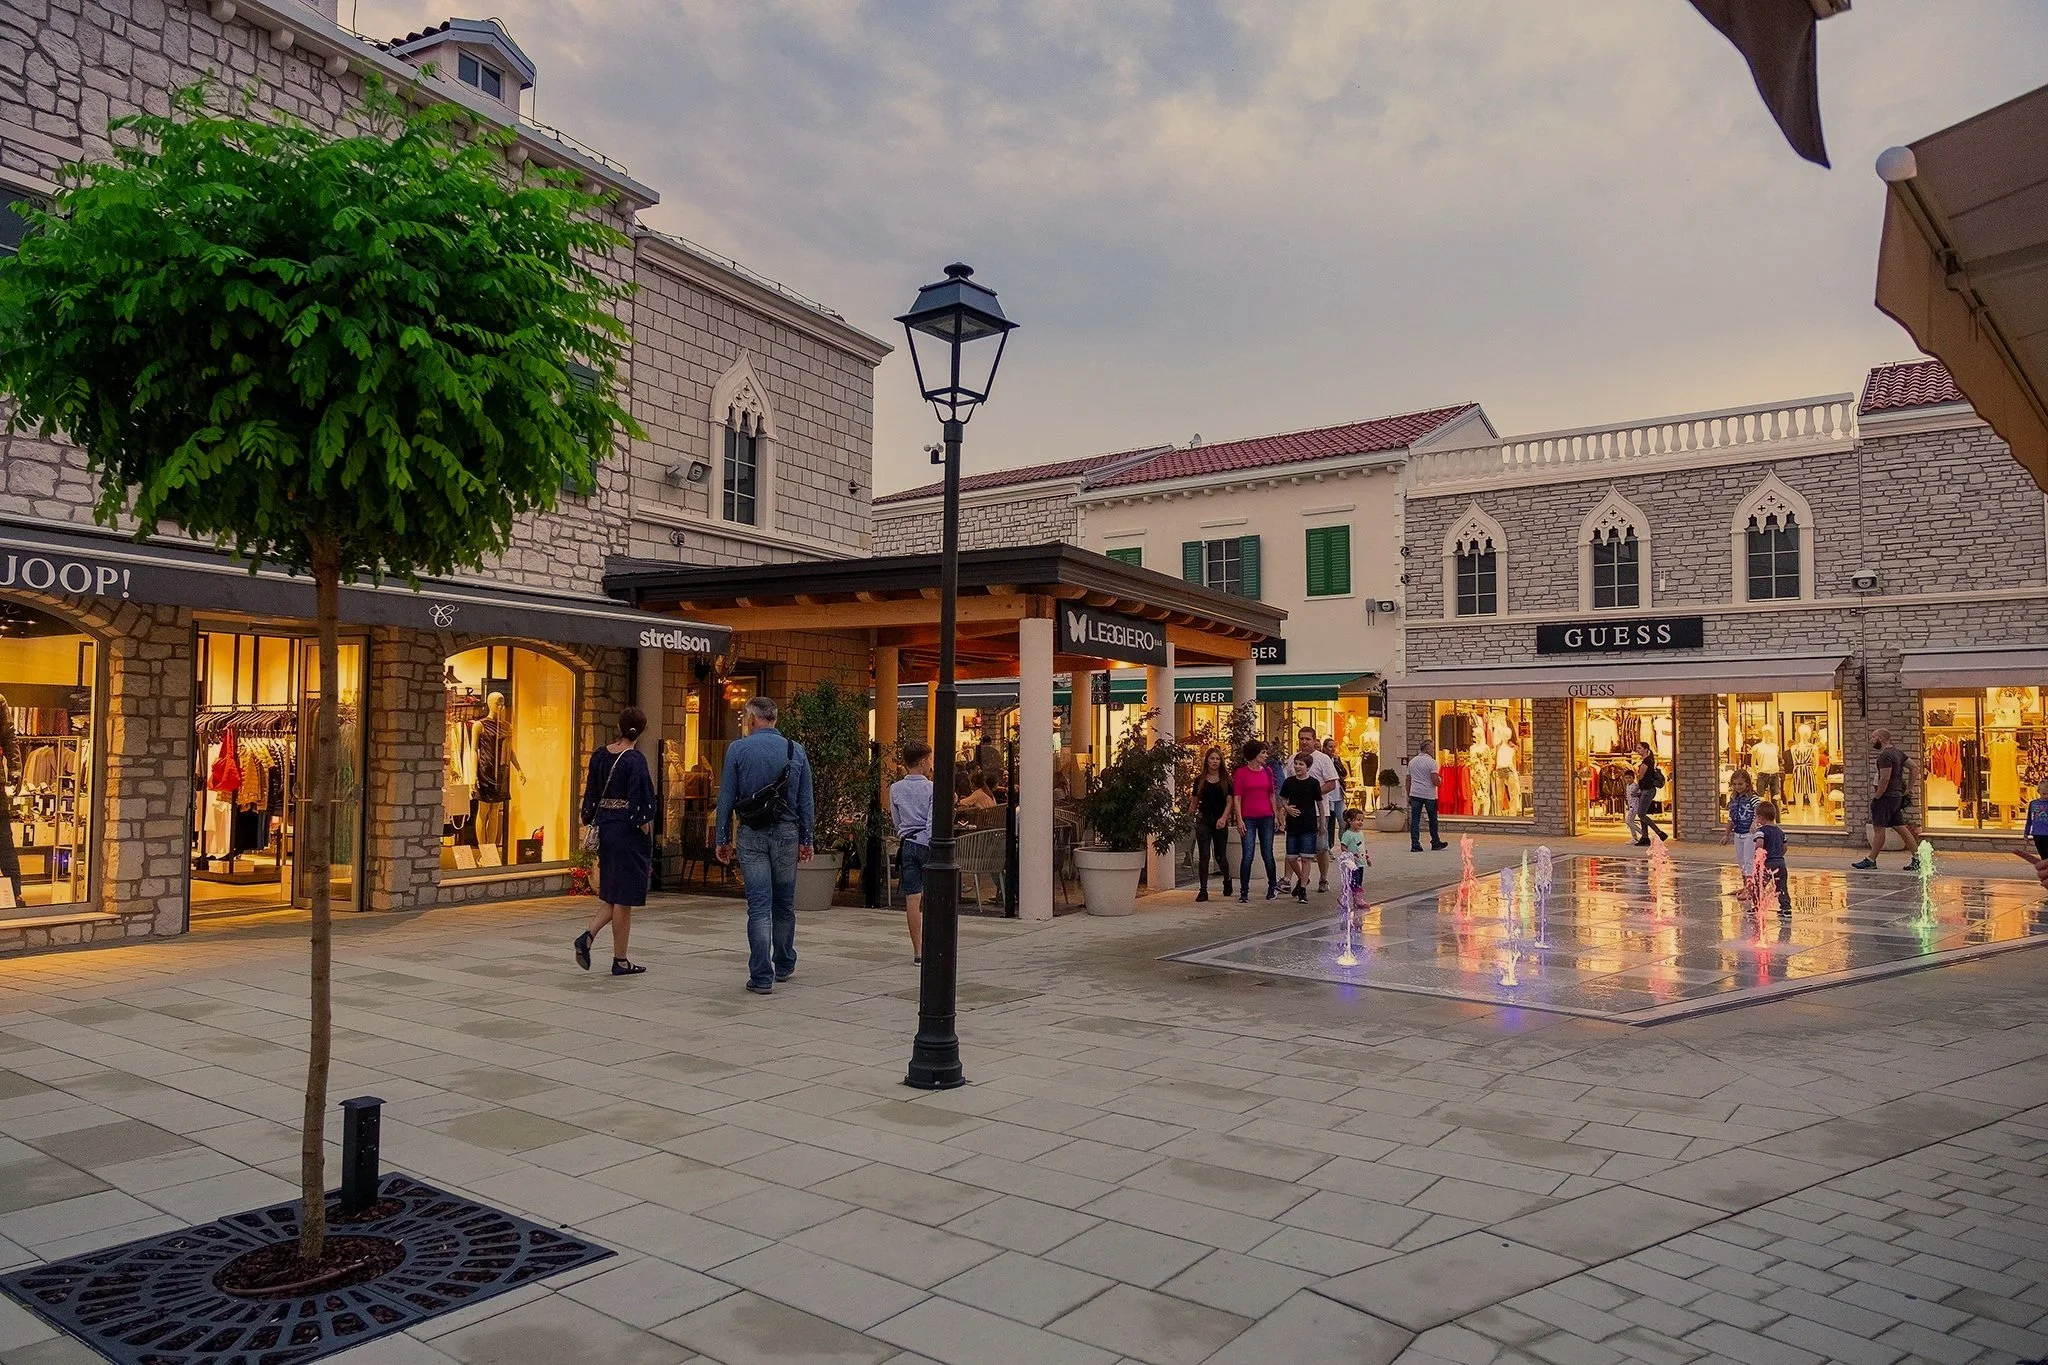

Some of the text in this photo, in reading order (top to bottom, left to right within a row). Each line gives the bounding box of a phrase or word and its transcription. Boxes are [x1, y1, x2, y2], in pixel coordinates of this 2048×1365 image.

[0, 555, 131, 599] JOOP!
[639, 628, 711, 653] strellson
[1088, 620, 1155, 650] LEGGIERO
[1564, 624, 1671, 648] GUESS
[1251, 646, 1277, 659] BER
[1183, 692, 1225, 703] WEBER
[1568, 684, 1615, 697] GUESS
